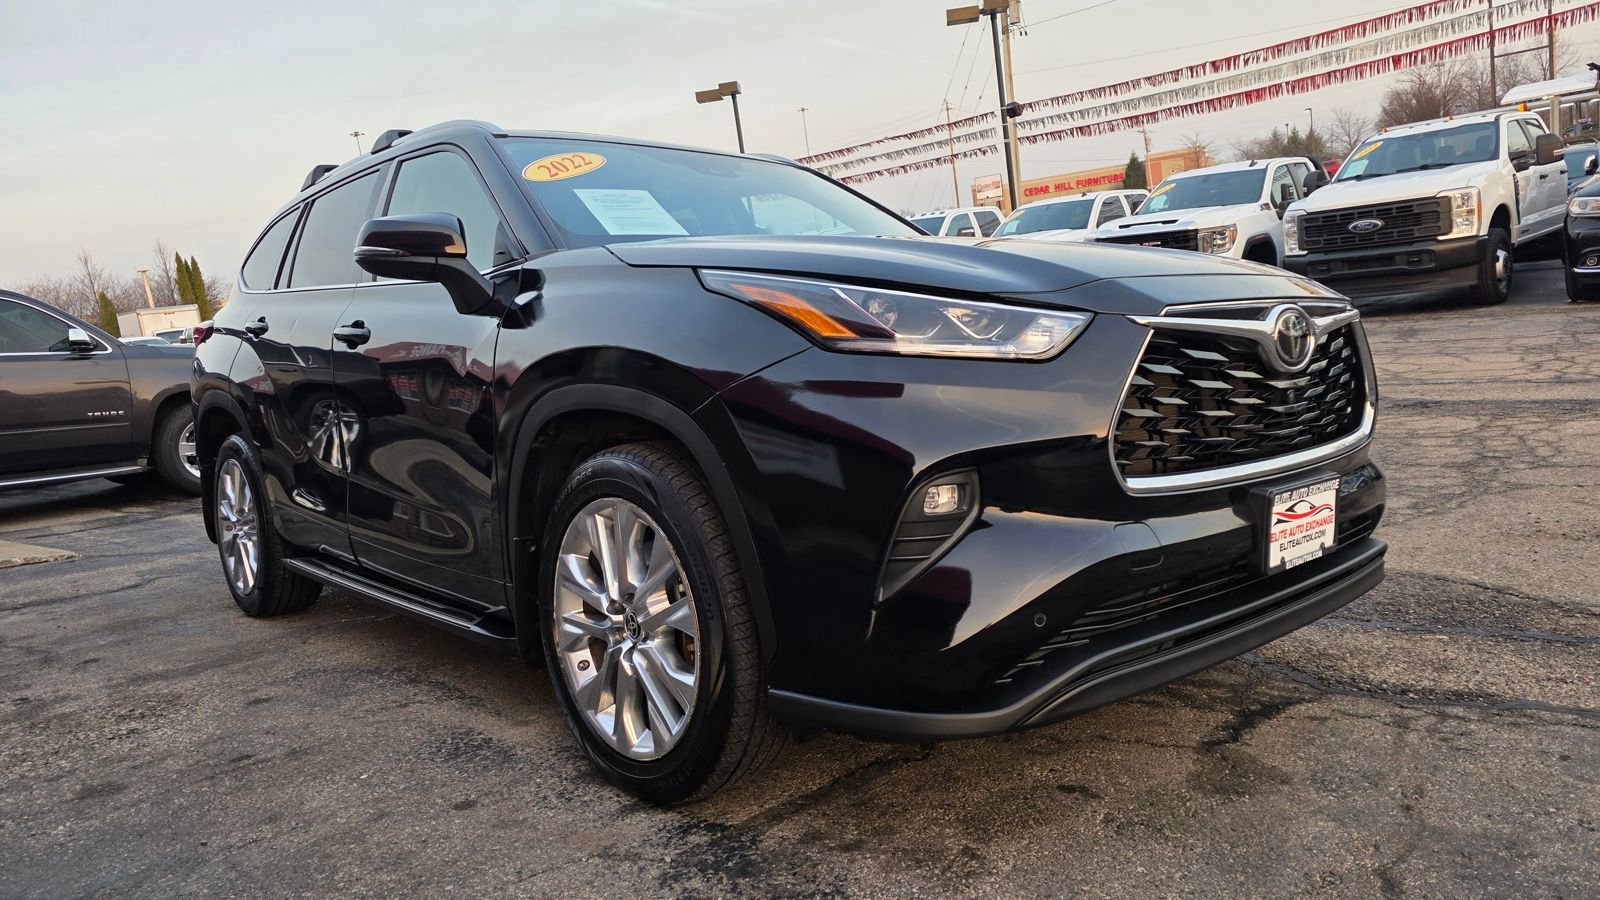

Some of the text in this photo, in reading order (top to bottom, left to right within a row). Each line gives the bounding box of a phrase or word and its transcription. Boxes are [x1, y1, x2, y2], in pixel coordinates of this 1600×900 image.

[537, 154, 593, 178] 2022
[1024, 185, 1050, 197] CEDAR
[1055, 181, 1073, 192] HILL
[1291, 487, 1308, 501] AUTO
[1309, 479, 1340, 494] EXCHANGE
[1269, 514, 1334, 543] ELITE AUTO EXCHANGE
[1280, 529, 1327, 552] ELITEAUTOX.COM
